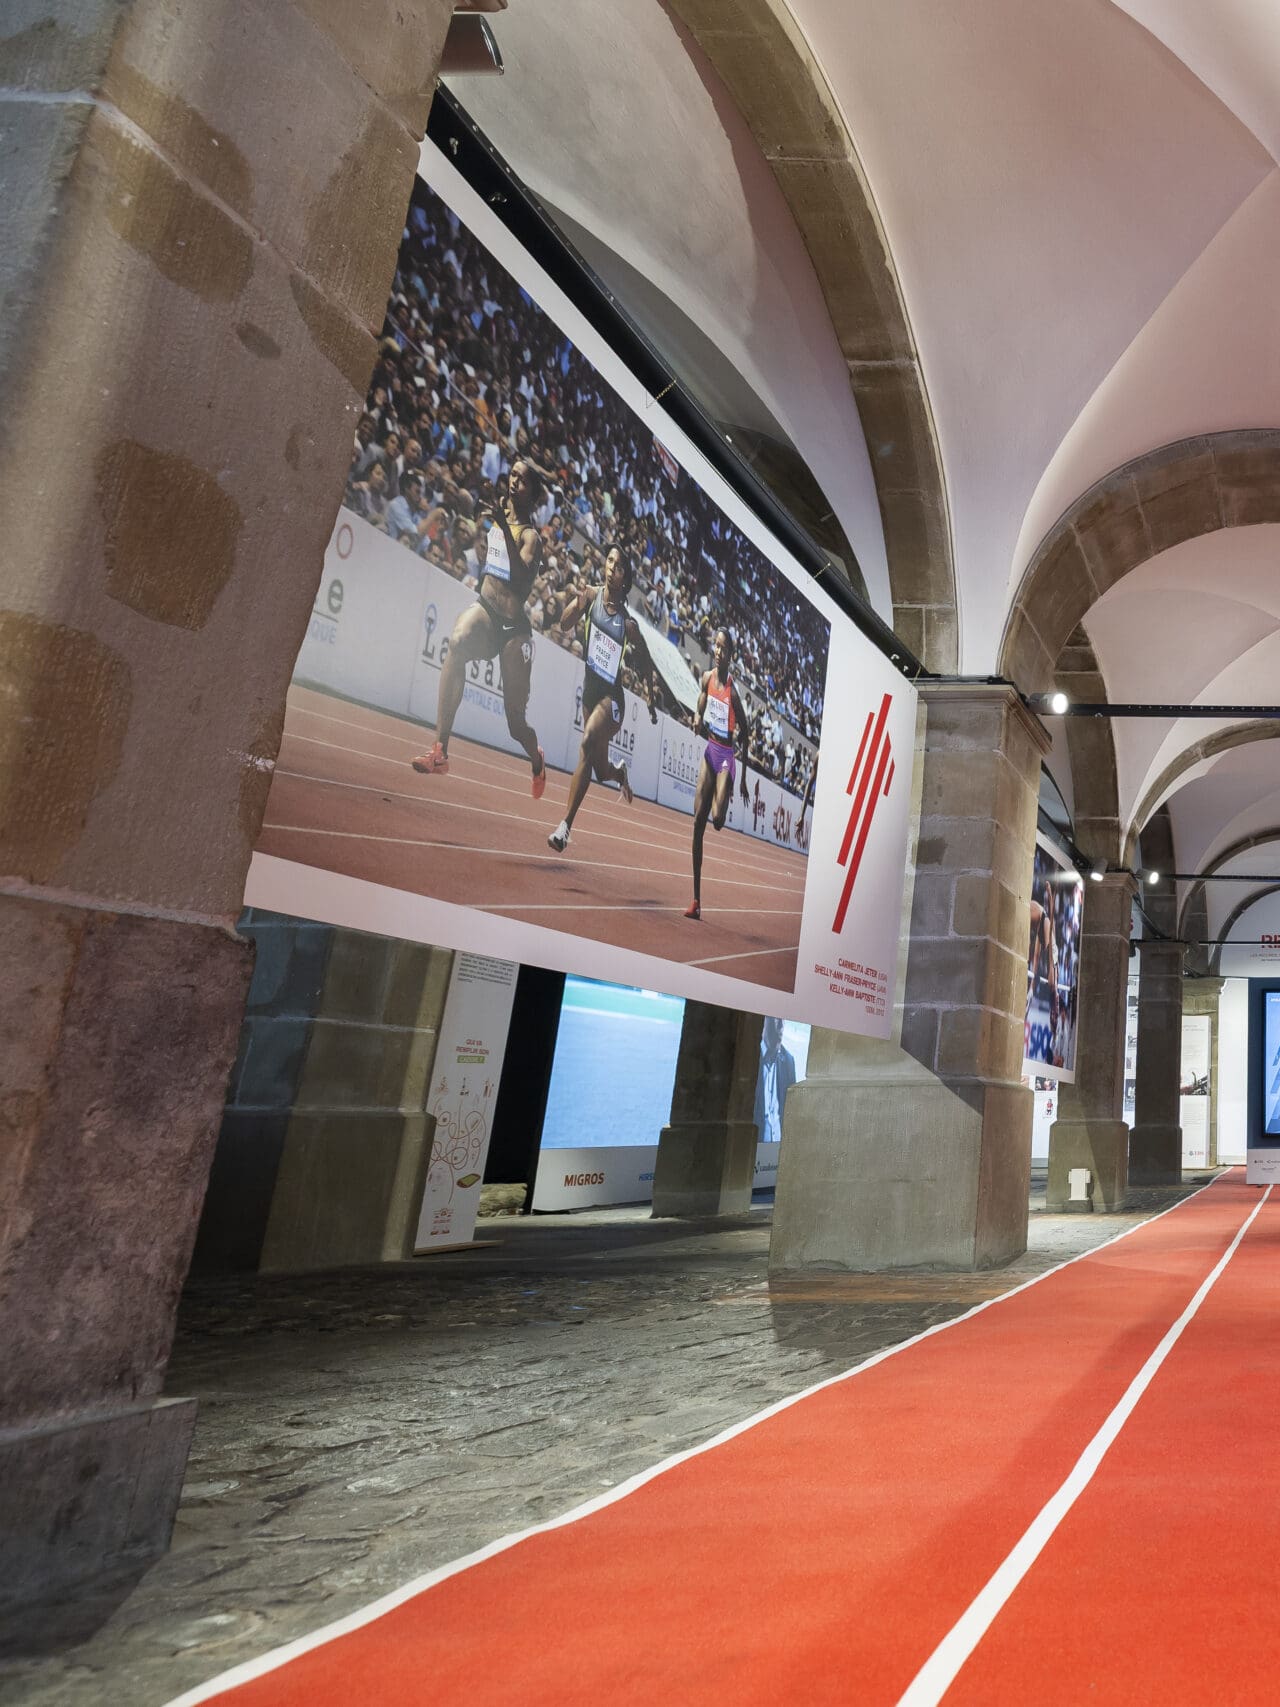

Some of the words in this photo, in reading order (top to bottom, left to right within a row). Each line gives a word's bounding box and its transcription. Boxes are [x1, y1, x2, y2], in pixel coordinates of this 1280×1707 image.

[464, 688, 490, 710] APITALE
[815, 964, 843, 980] SHELLY-ANN
[844, 974, 877, 991] FRASER-PRYCE
[838, 958, 863, 973] CARMELITA
[864, 967, 877, 978] JETER
[830, 984, 854, 997] KELLY-ANN
[855, 991, 876, 1004] BAPTISTE
[564, 1172, 605, 1187] MIGROS
